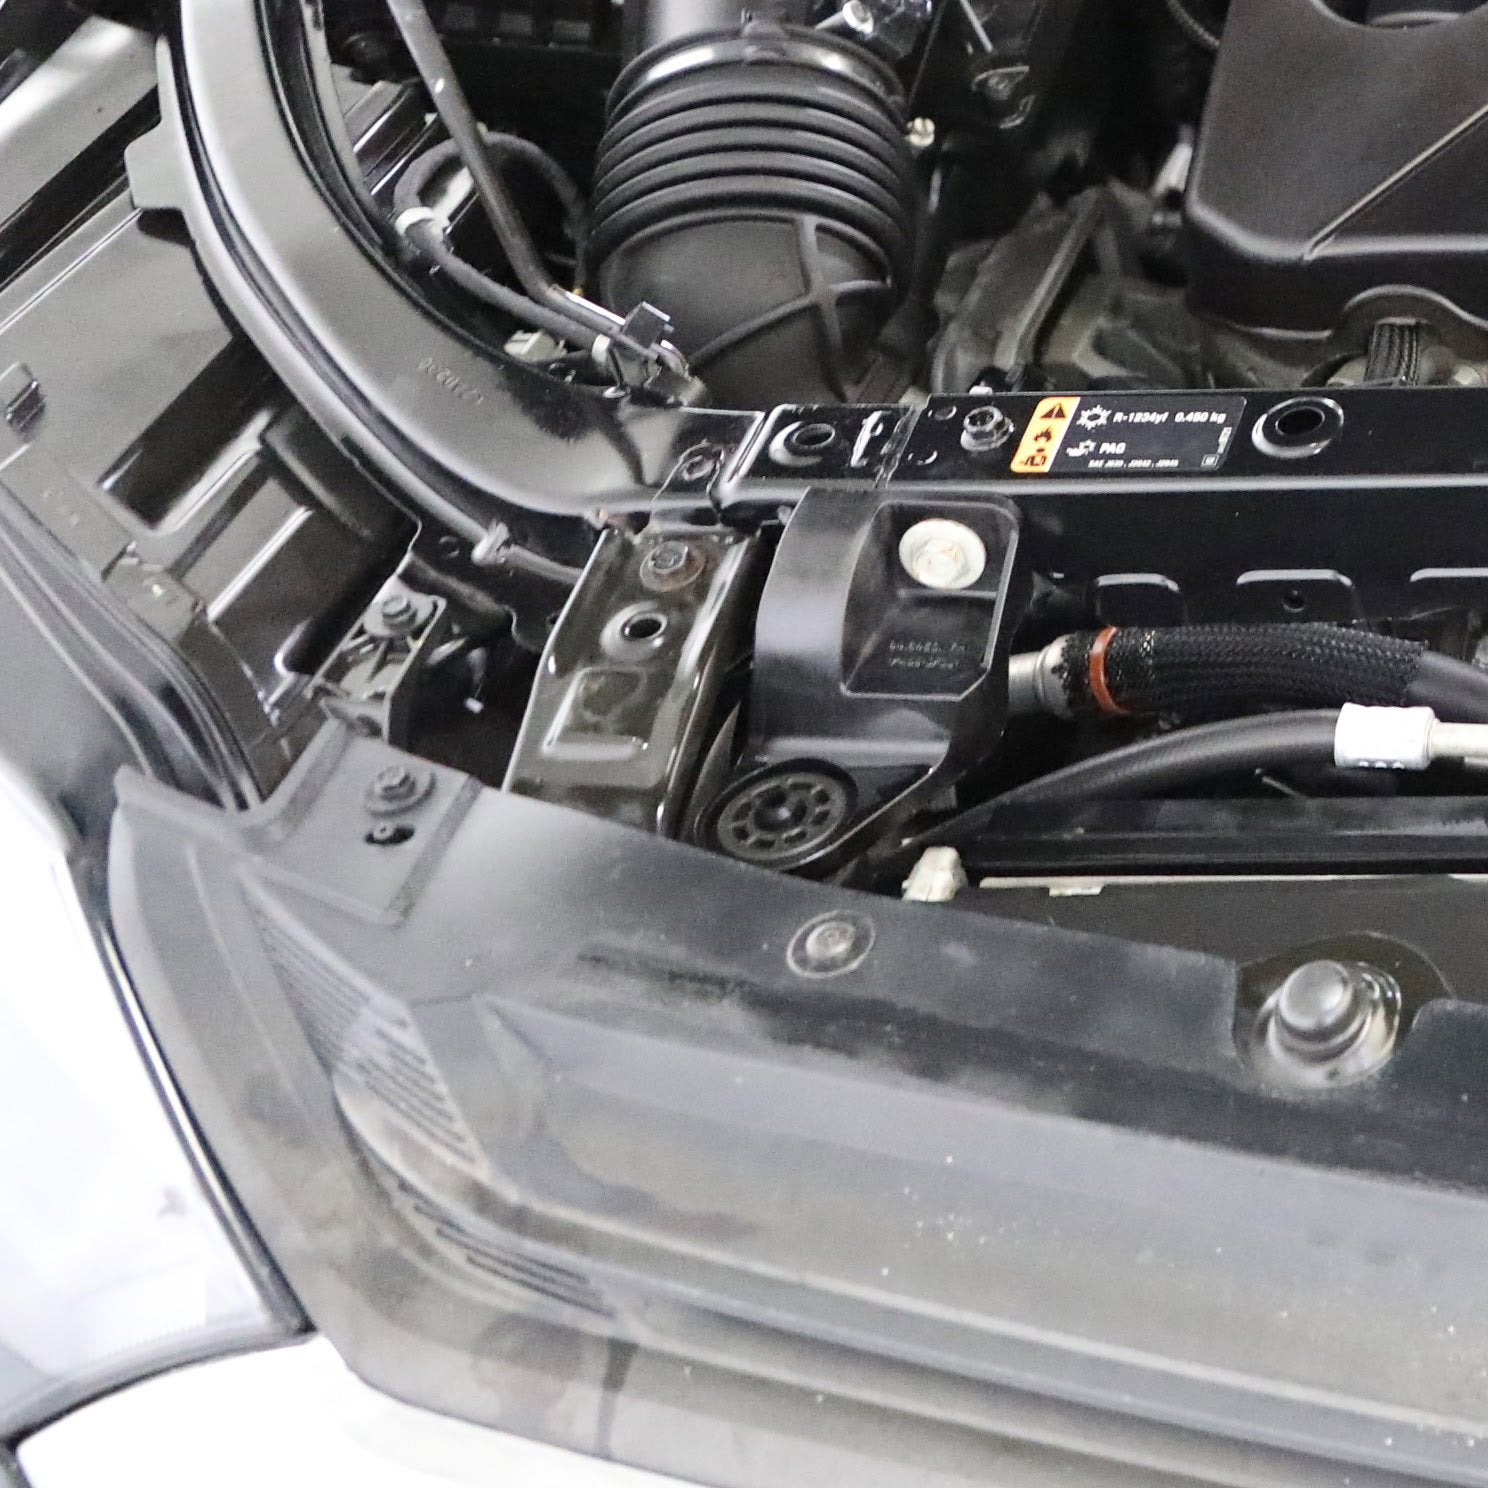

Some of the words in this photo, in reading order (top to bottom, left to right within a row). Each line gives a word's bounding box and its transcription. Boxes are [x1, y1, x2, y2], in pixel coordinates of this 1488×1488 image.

[1112, 411, 1169, 424] R-1234yf
[1209, 411, 1227, 424] kg
[1099, 442, 1127, 454] PAG
